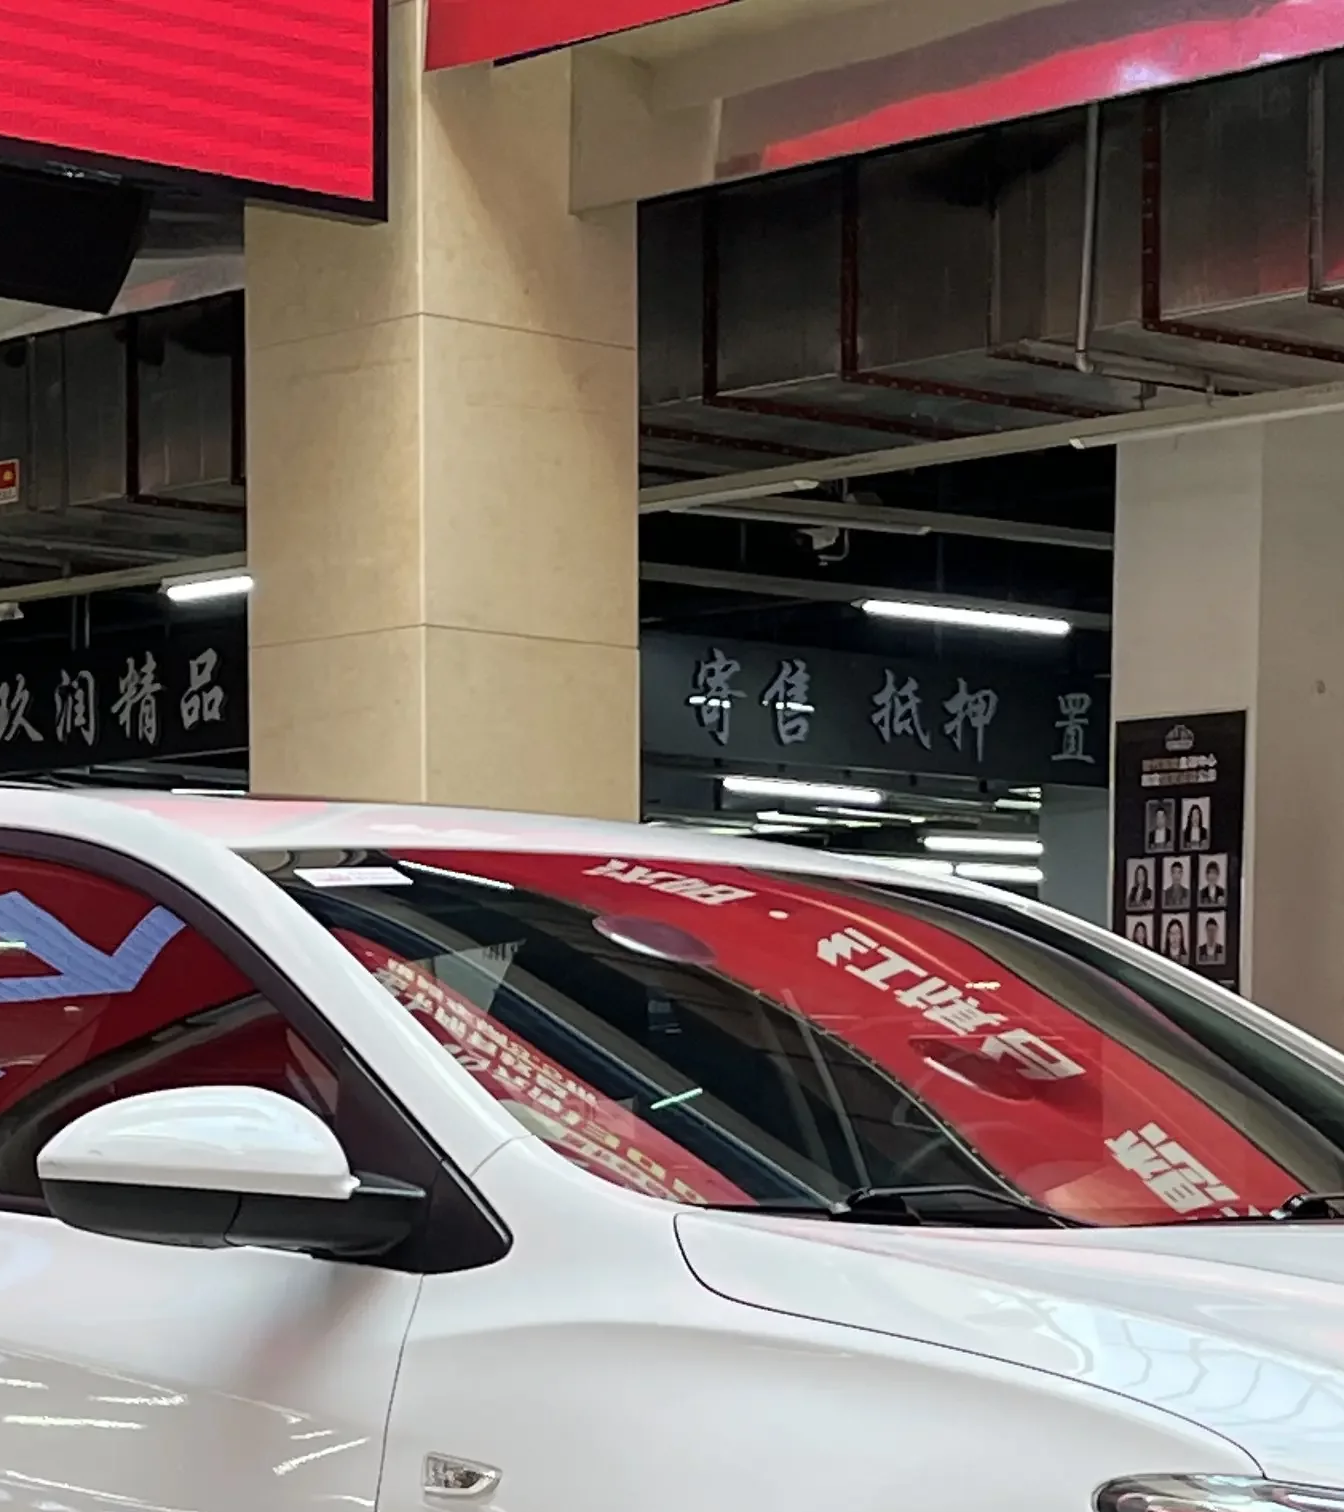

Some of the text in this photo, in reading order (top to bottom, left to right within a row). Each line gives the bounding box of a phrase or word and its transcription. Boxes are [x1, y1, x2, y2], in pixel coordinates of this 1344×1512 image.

[688, 647, 1096, 765] 寄售 抵押 置
